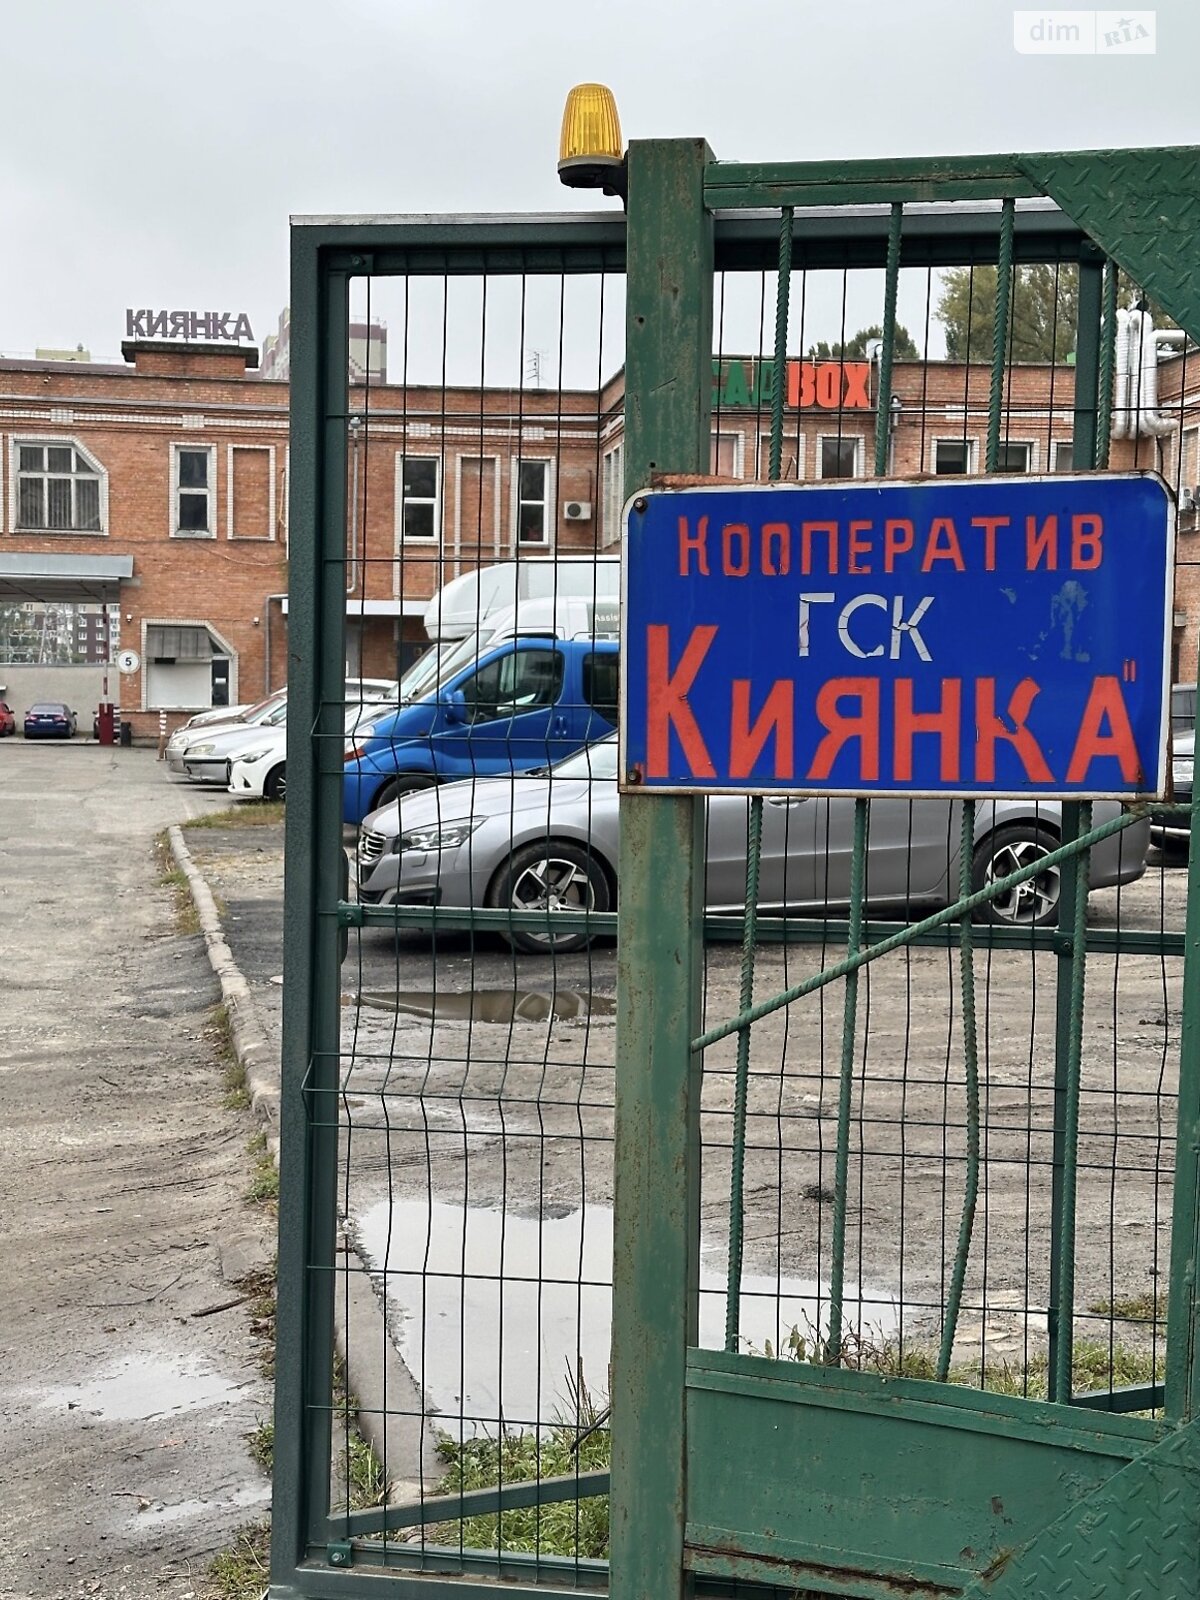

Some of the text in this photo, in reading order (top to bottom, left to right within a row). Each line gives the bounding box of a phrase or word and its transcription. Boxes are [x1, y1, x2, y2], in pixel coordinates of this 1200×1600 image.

[126, 308, 255, 341] КИЯНКА
[678, 514, 1104, 576] КООПЕРАТИВ
[798, 592, 934, 661] ГСК
[125, 657, 132, 667] 5
